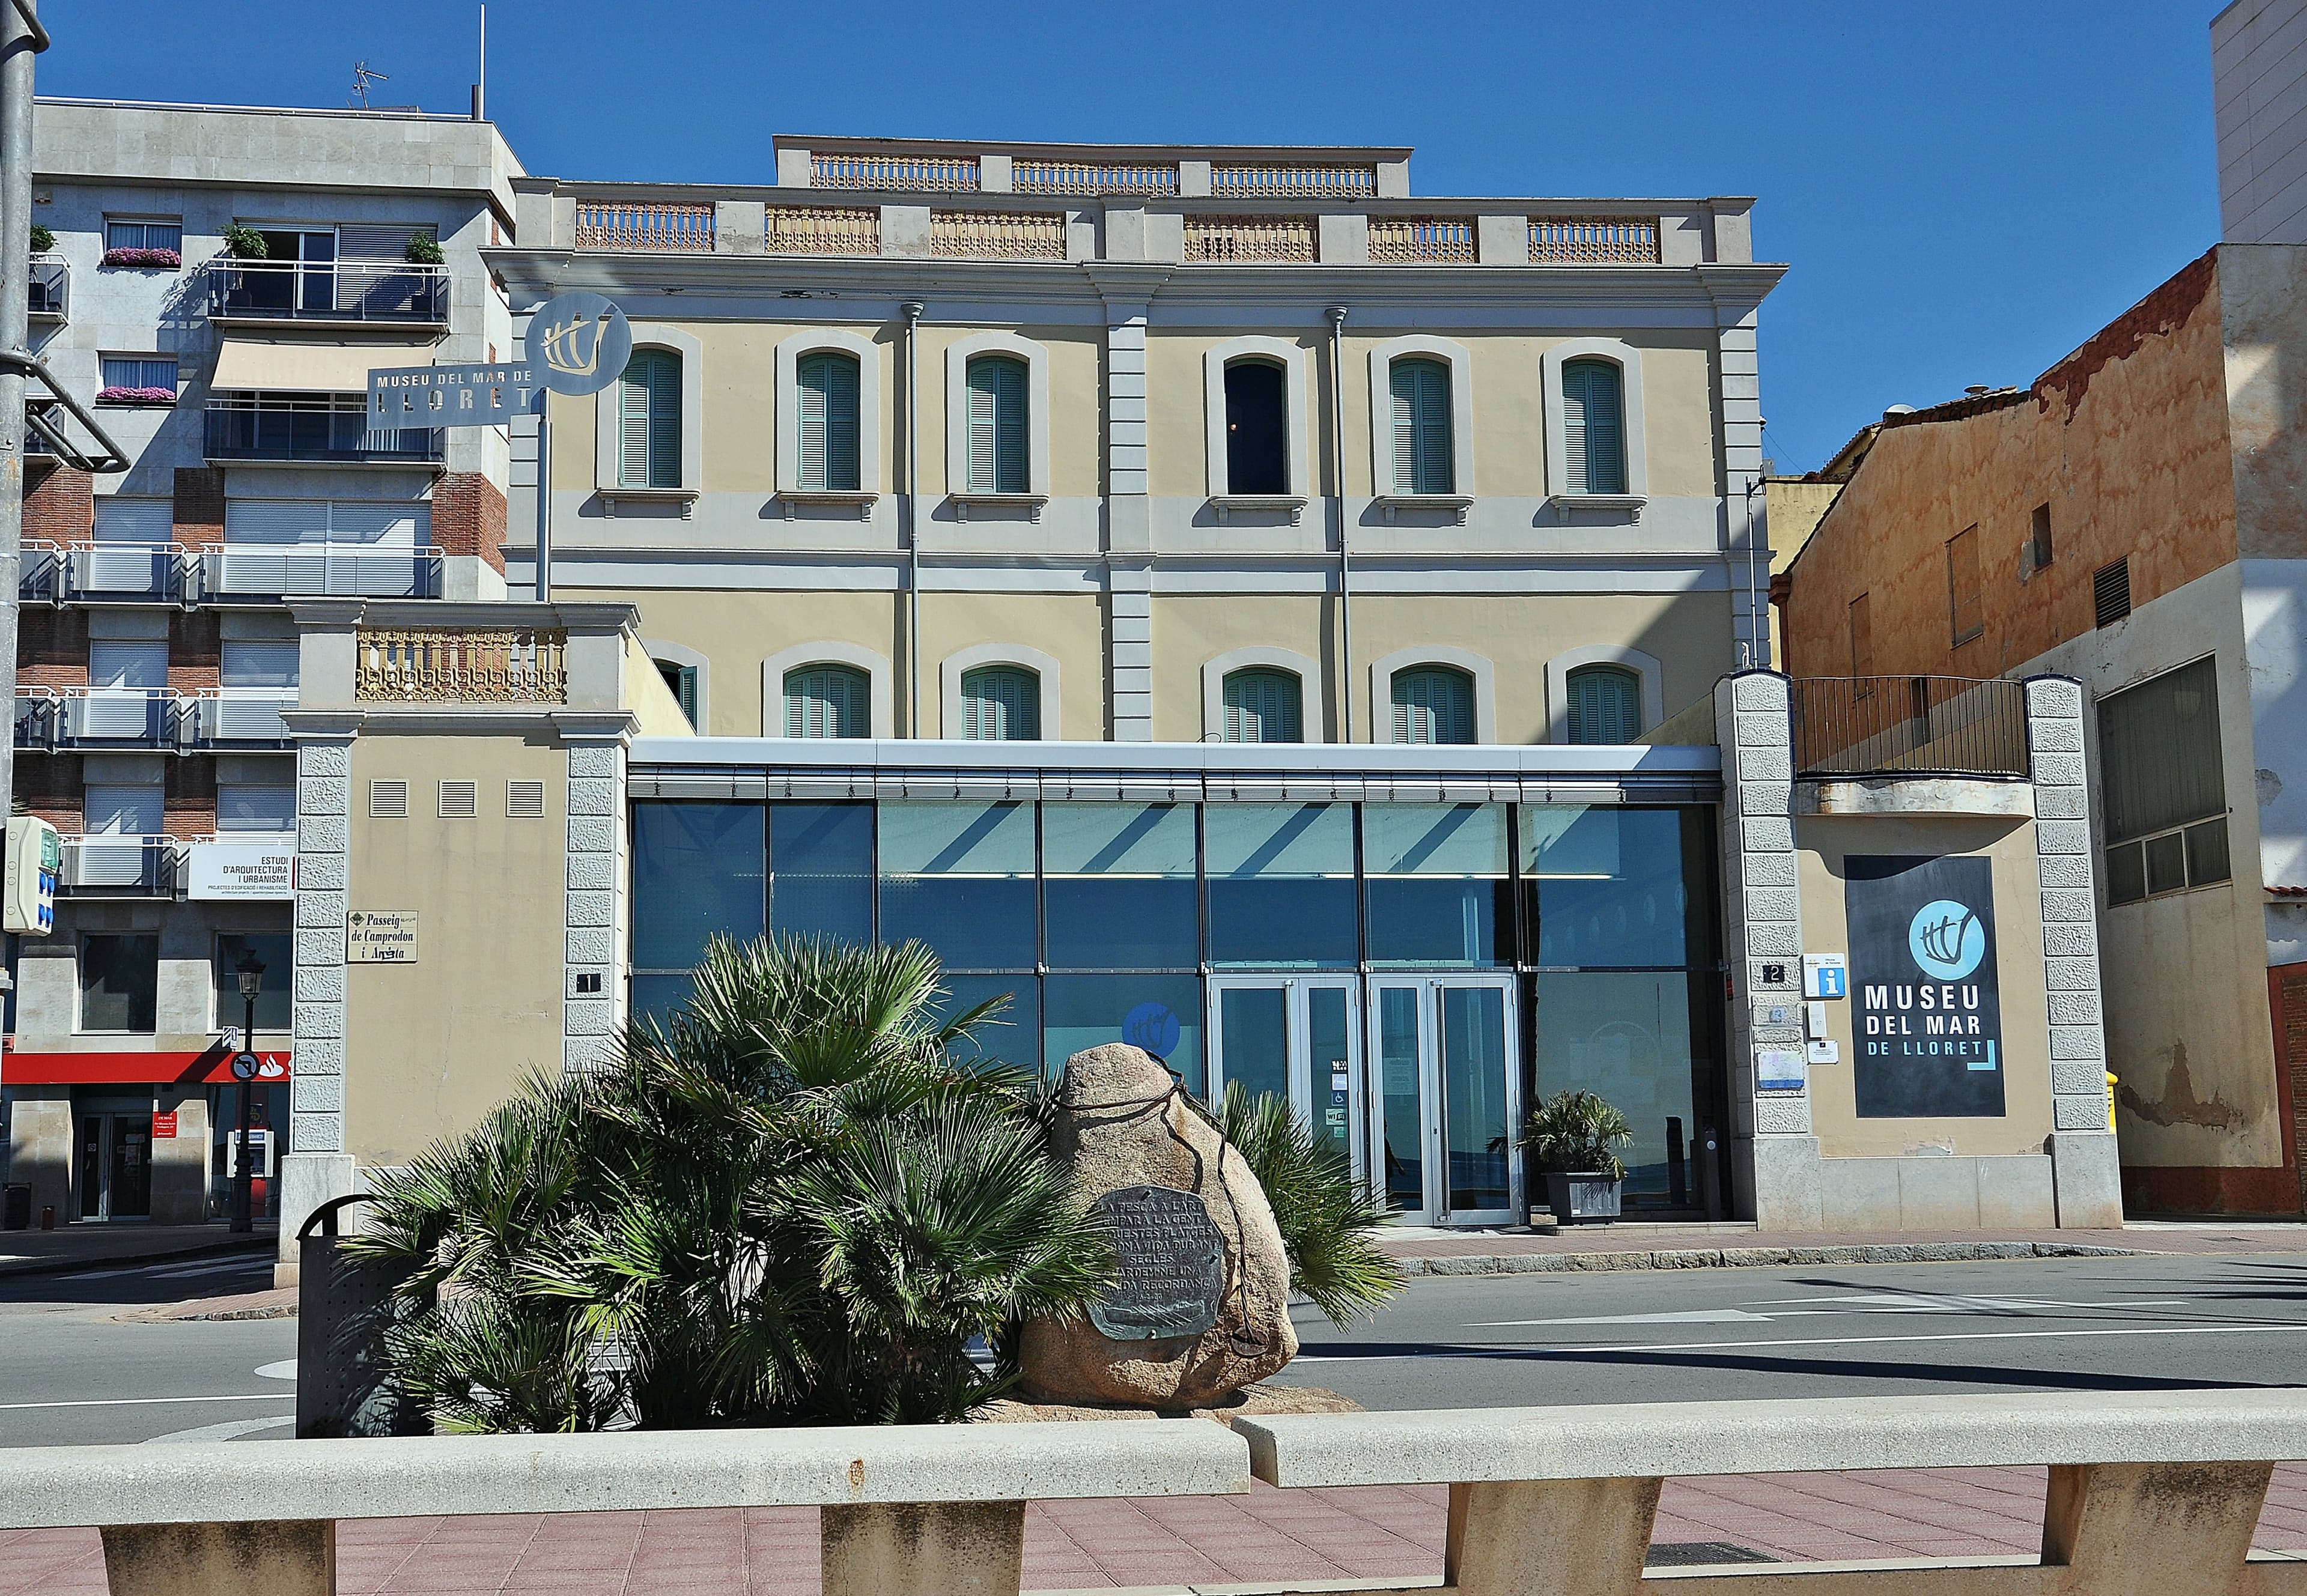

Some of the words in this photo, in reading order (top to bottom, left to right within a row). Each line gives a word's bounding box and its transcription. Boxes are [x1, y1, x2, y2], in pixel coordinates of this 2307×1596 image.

[377, 375, 429, 388] MUSEU
[438, 373, 464, 385] DEL
[473, 371, 505, 384] MAR
[514, 371, 531, 381] DE
[377, 386, 531, 413] LLORET
[261, 857, 288, 865] ESTUDI
[223, 866, 288, 874] D'ARQUITECTURA
[367, 914, 400, 929] Passeig
[351, 929, 362, 941] de
[365, 929, 413, 945] Camprodon
[362, 947, 365, 959] i
[1769, 966, 1780, 981] 2
[1864, 985, 1979, 1010] MUSEU
[1866, 1015, 1912, 1035] DEL
[1926, 1015, 1981, 1035] MAR
[1867, 1041, 1889, 1055] DE
[1903, 1041, 1981, 1055] LLORET
[1118, 1202, 1157, 1212] PESCA
[1160, 1201, 1168, 1211] A
[1153, 1214, 1170, 1225] LA
[1162, 1226, 1213, 1237] PLATGES
[1143, 1240, 1169, 1251] VIDA
[1172, 1240, 1218, 1250] DURANT
[1178, 1266, 1201, 1275] UNA
[1141, 1277, 1217, 1290] RECORDANÇA
